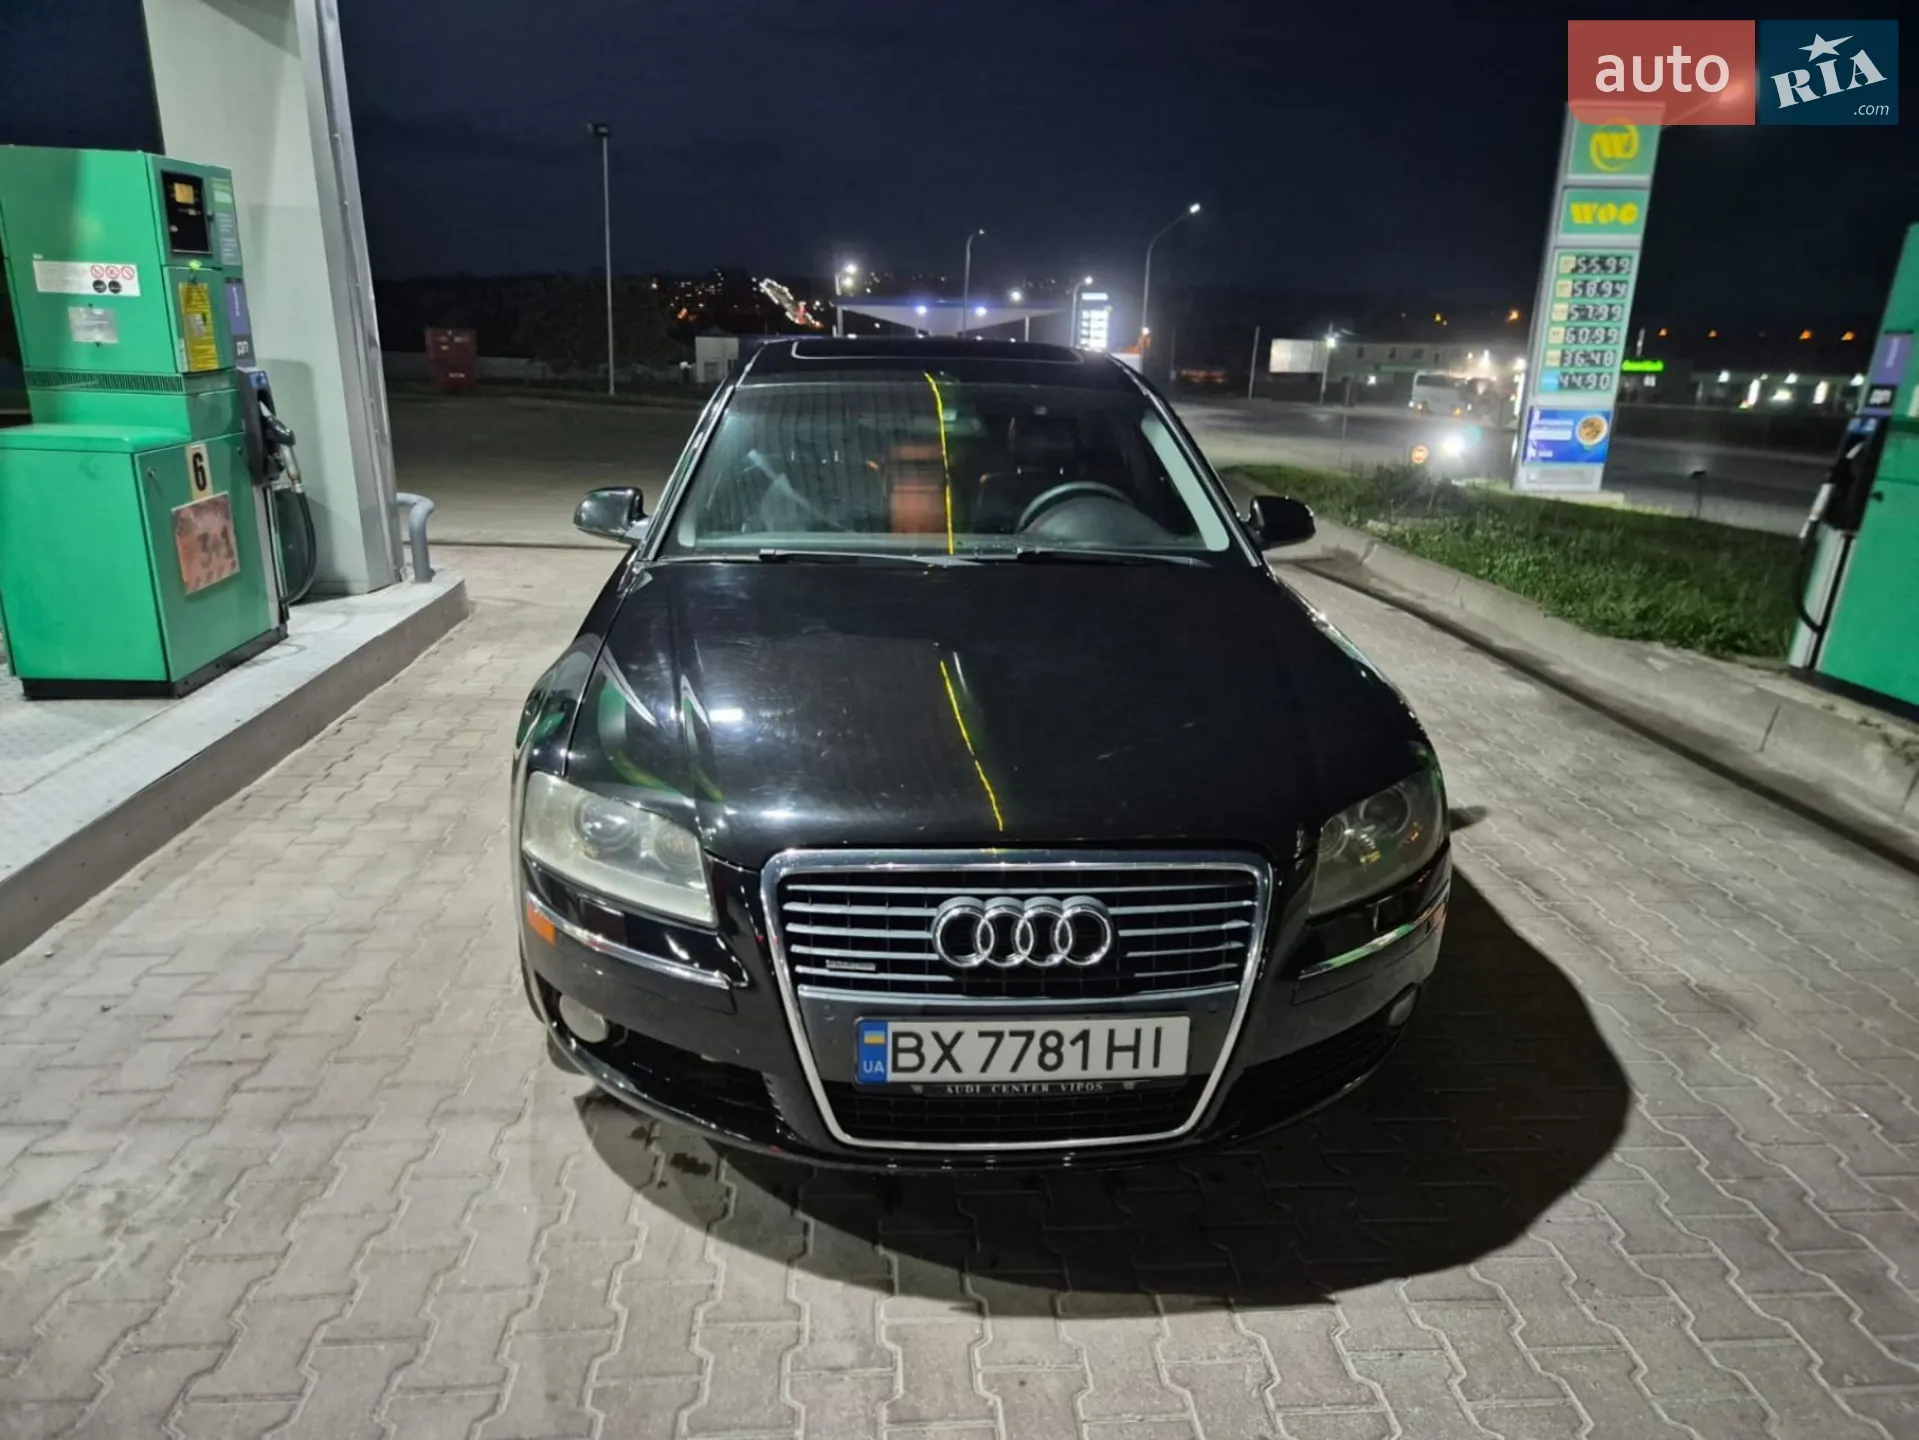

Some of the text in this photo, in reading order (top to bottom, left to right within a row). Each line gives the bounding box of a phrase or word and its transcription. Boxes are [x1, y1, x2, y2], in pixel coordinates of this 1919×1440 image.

[192, 452, 207, 492] 6
[891, 1026, 1164, 1074] BX 7781 HI
[863, 1060, 885, 1074] UA
[945, 1084, 981, 1094] AUDI
[991, 1083, 1050, 1094] CENTER
